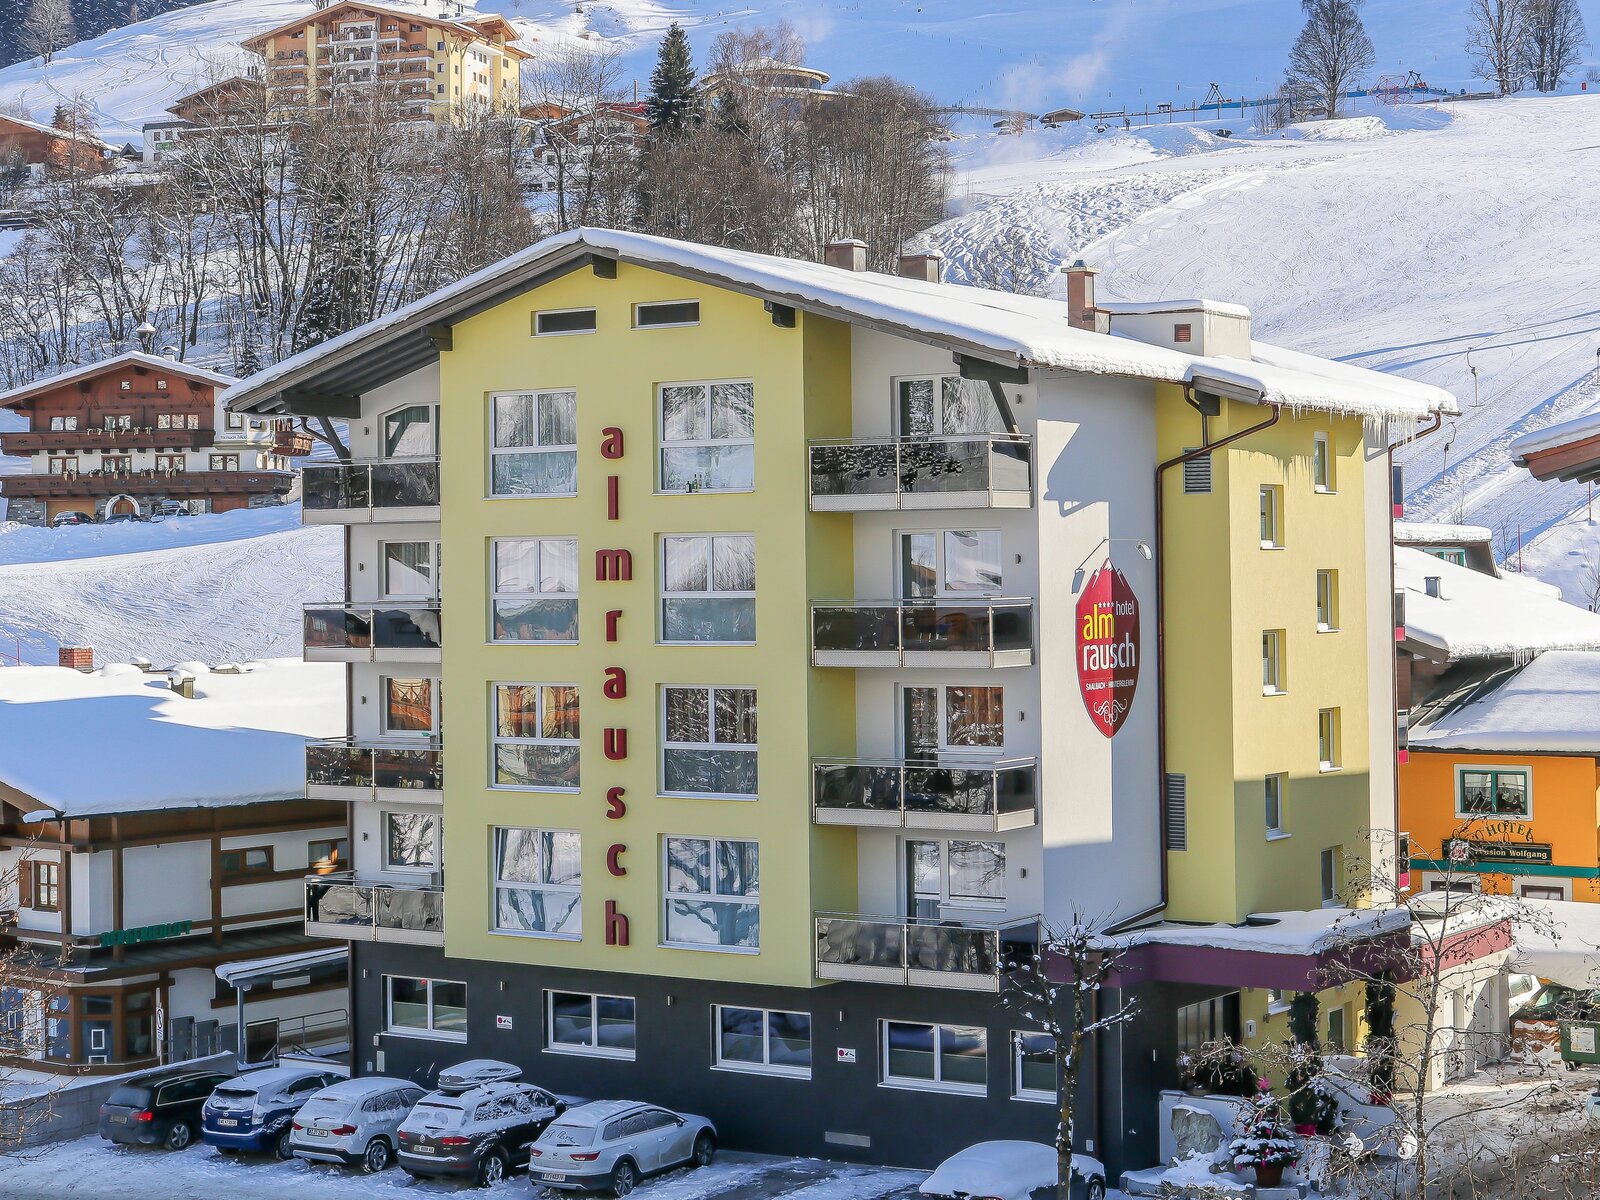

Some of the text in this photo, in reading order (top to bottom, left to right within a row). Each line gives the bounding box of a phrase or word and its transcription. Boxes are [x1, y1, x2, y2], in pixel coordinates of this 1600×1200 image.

[1116, 600, 1134, 616] hotel
[1083, 603, 1115, 641] alm
[1083, 632, 1135, 671] rausch
[595, 427, 633, 947] almrausch
[1086, 681, 1106, 691] SAALBACH
[1485, 821, 1534, 837] HOTEL
[1510, 849, 1548, 860] Wolfgang
